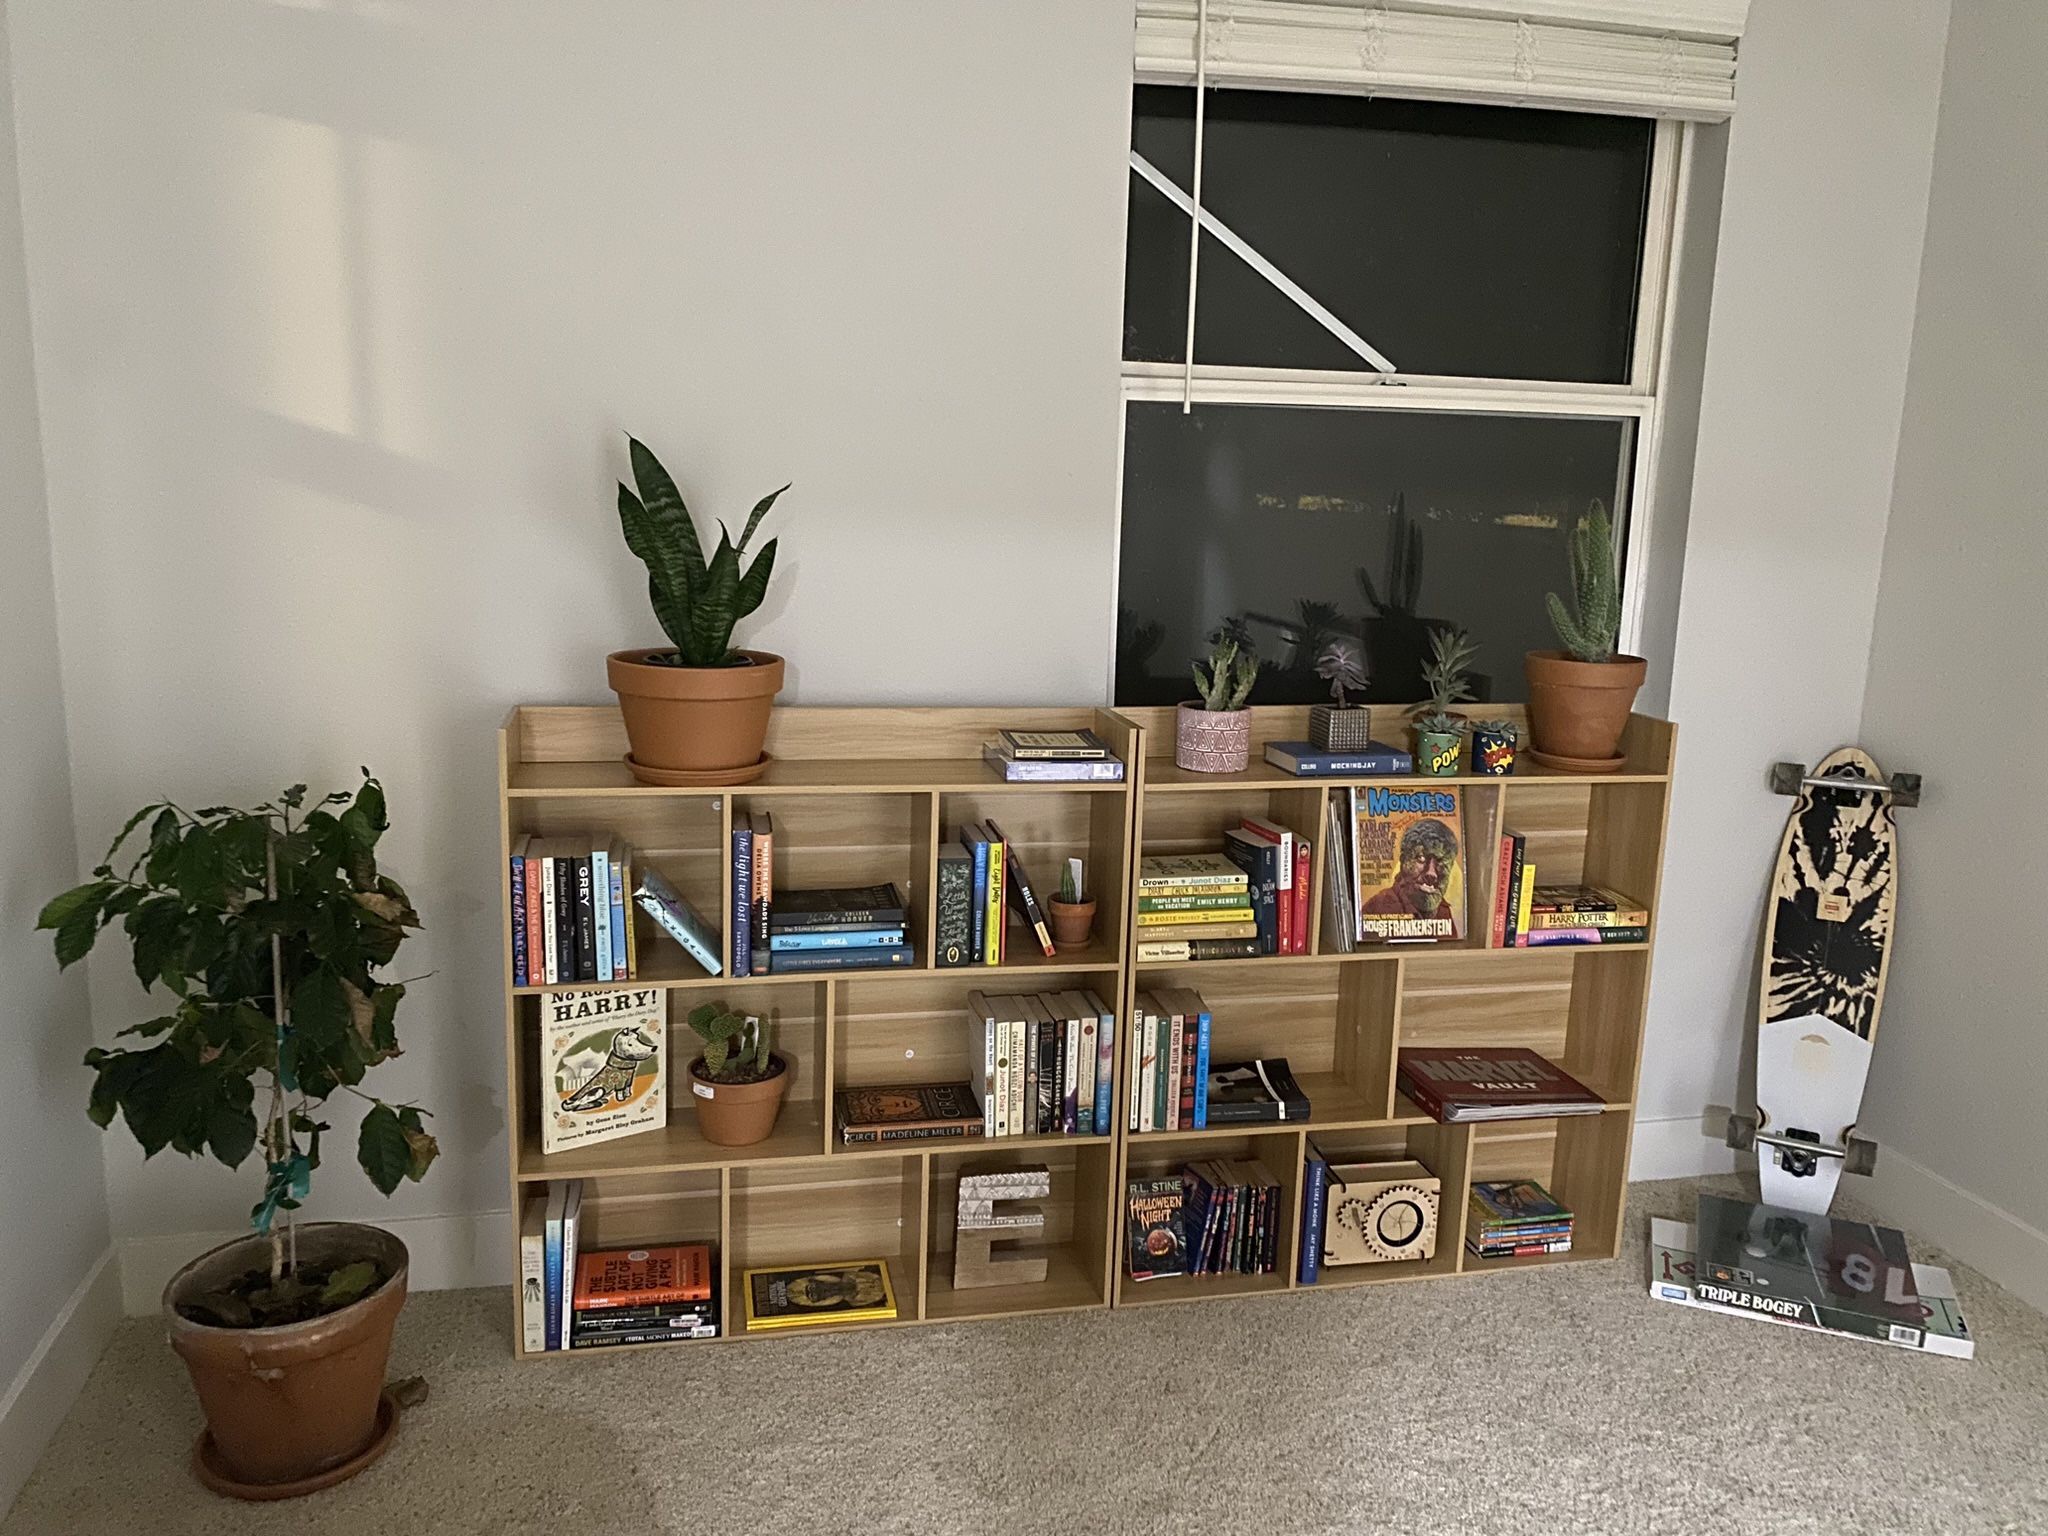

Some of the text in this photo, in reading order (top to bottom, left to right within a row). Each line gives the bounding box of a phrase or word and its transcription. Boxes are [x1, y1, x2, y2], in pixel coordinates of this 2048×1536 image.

[1368, 787, 1455, 818] MONSTERS
[1502, 841, 1510, 865] CRAZY
[579, 866, 590, 906] GREY
[735, 837, 750, 922] the light we lost
[1142, 879, 1169, 887] Drown
[1189, 877, 1212, 885] Junot
[761, 882, 769, 921] CRAWDADS
[1497, 886, 1506, 913] ASIANS
[1363, 920, 1388, 933] HOUSE
[1388, 919, 1452, 937] FRANKENSTEIN
[1548, 913, 1609, 923] HARRY POTTER
[553, 989, 657, 1022] HARRY!
[1171, 1066, 1179, 1074] US
[1409, 1060, 1561, 1081] MARVEL
[933, 1087, 960, 1118] CIRCE
[585, 1126, 614, 1135] Margaret
[630, 1116, 655, 1125] Graham
[848, 1132, 876, 1141] CIRCE
[882, 1127, 962, 1140] MADELINE MILLER
[1129, 1180, 1182, 1194] R.L. STINE
[1129, 1194, 1182, 1221] HALLOWEEN
[954, 1166, 1050, 1290] E
[1141, 1208, 1172, 1232] NIGHT
[603, 1260, 618, 1293] SUBTLE
[617, 1260, 632, 1292] ART OF
[631, 1271, 644, 1291] NOT
[645, 1258, 659, 1290] GIVING
[661, 1280, 672, 1289] A
[590, 1276, 603, 1295] THE
[1698, 1284, 1751, 1308] TRIPLE
[1752, 1294, 1804, 1319] BOGEY
[575, 1338, 621, 1347] DAVE RAMSEY
